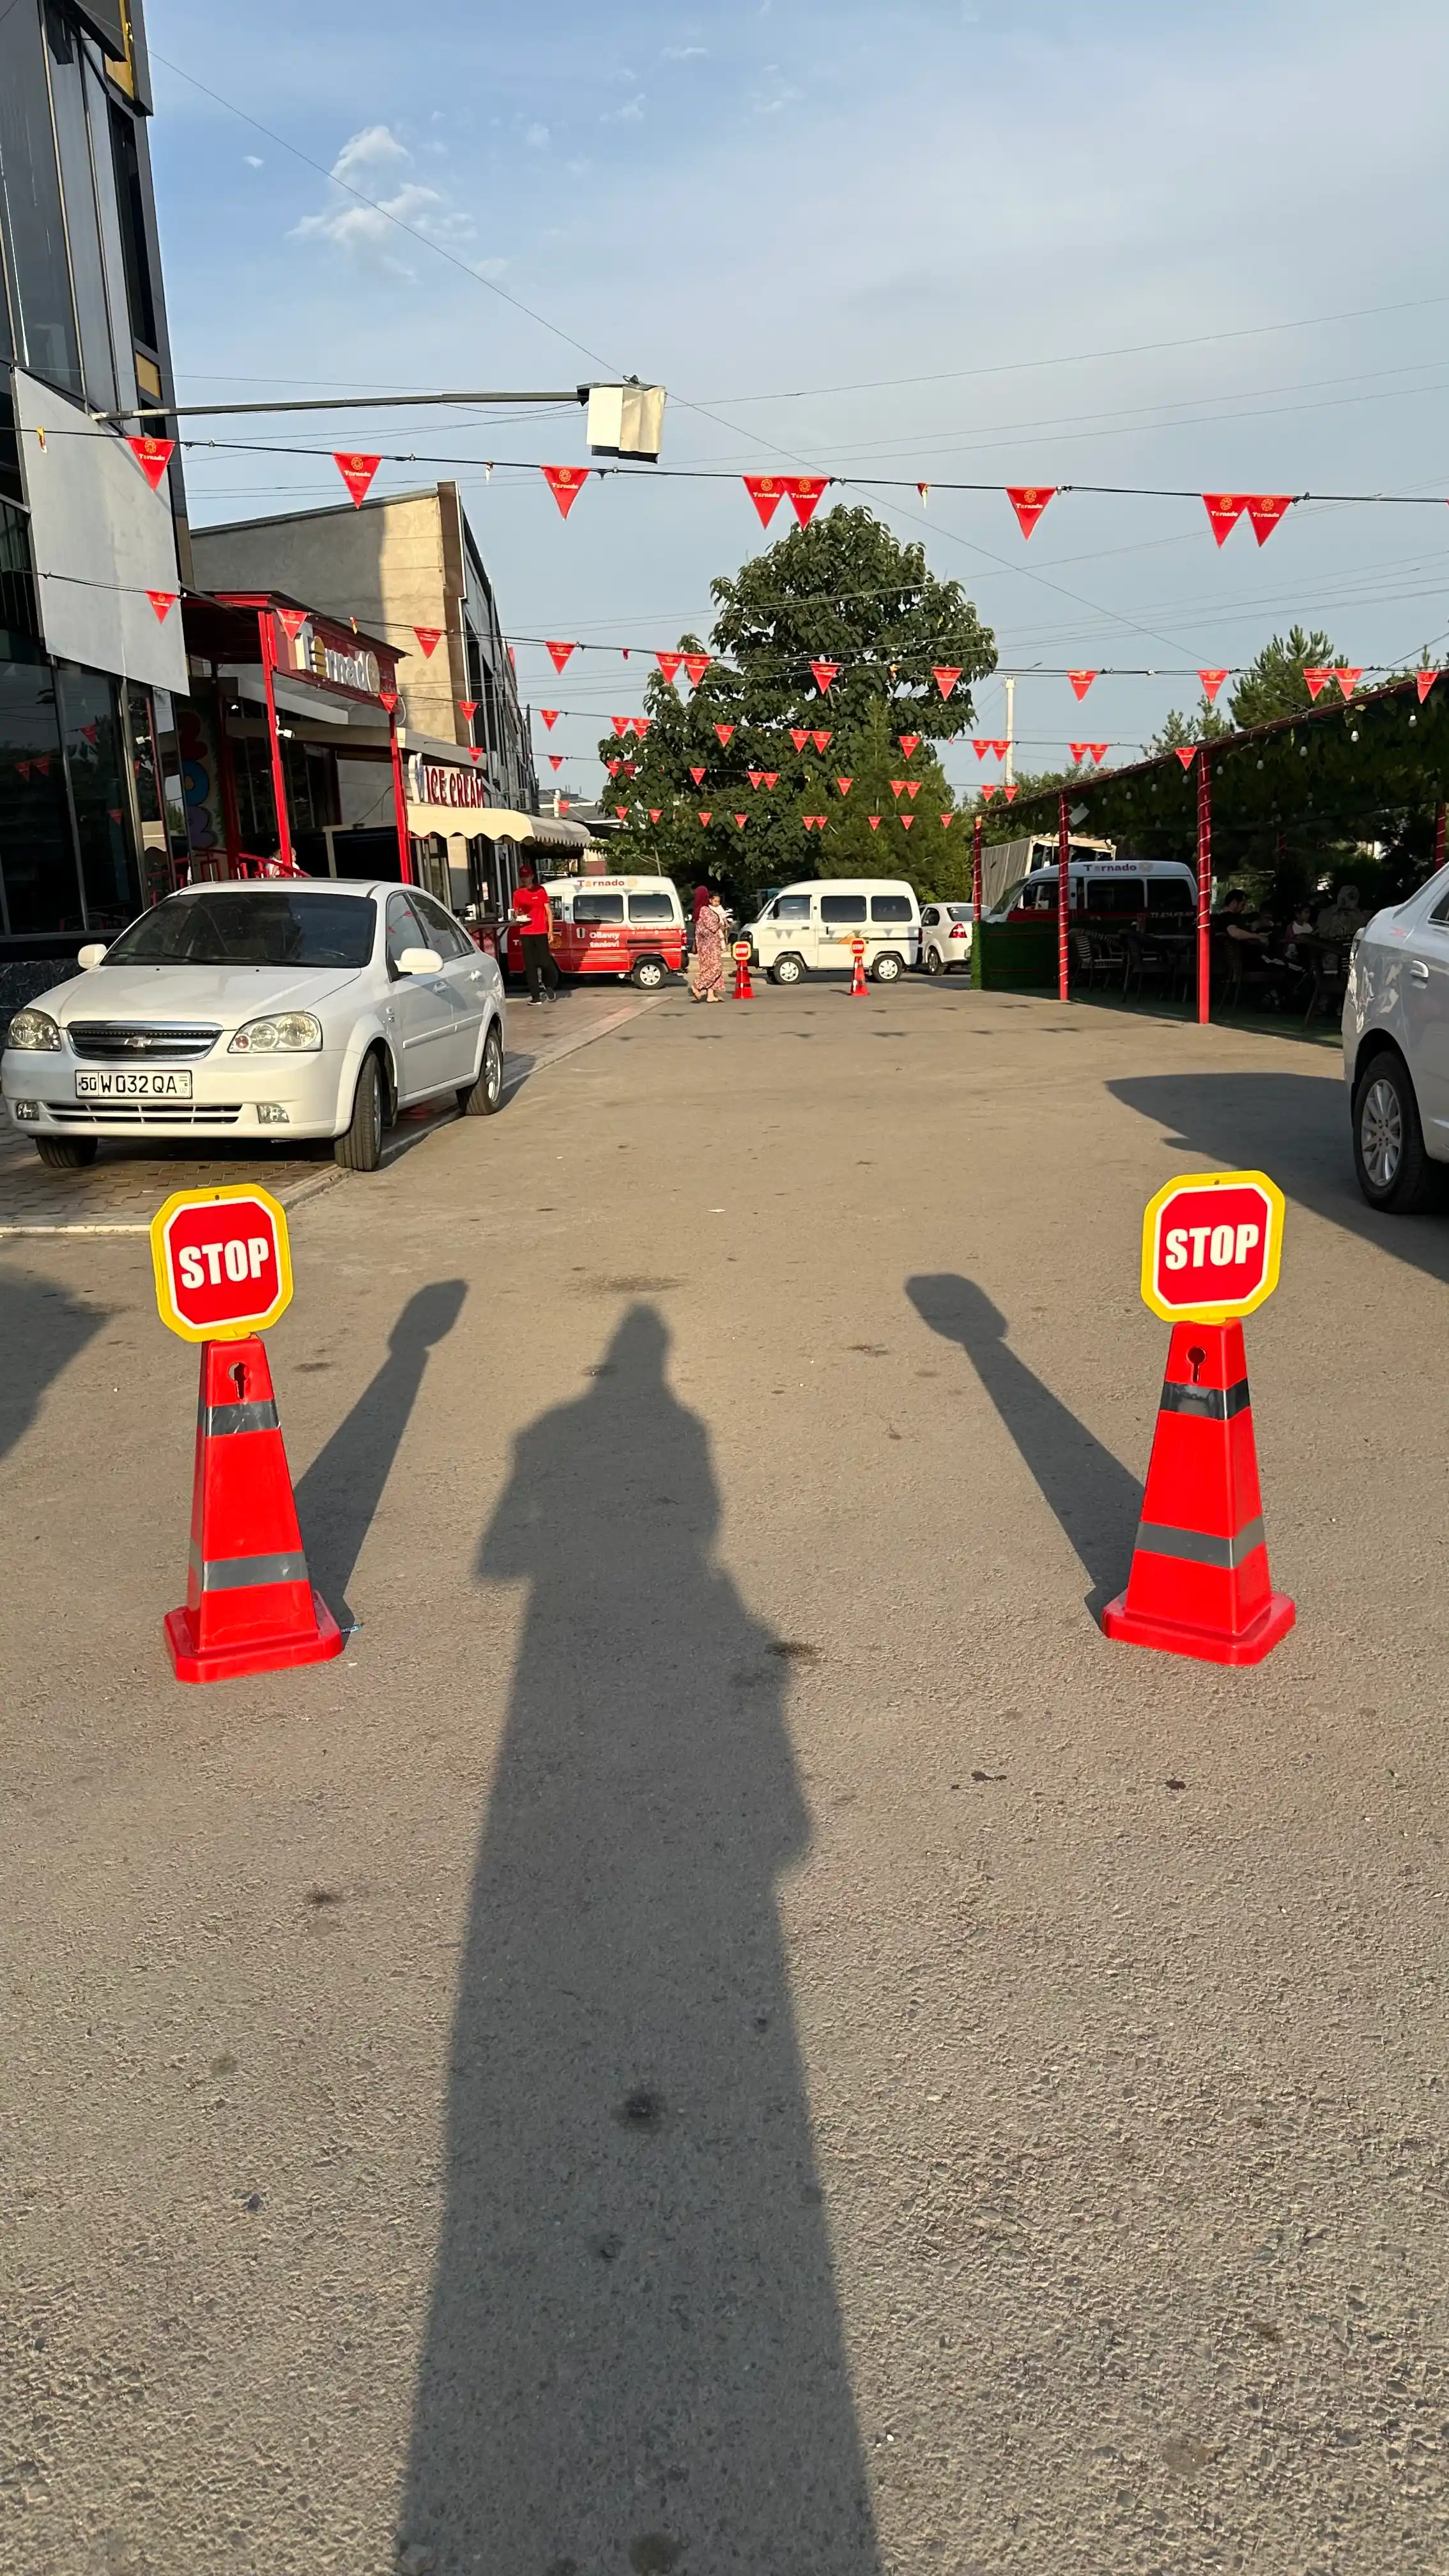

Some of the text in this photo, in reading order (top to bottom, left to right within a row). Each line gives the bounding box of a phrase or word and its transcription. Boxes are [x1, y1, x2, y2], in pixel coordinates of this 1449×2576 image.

[425, 766, 447, 806] ICE
[80, 1077, 97, 1091] 50
[178, 1237, 270, 1289] STOP
[1165, 1223, 1259, 1271] STOP
